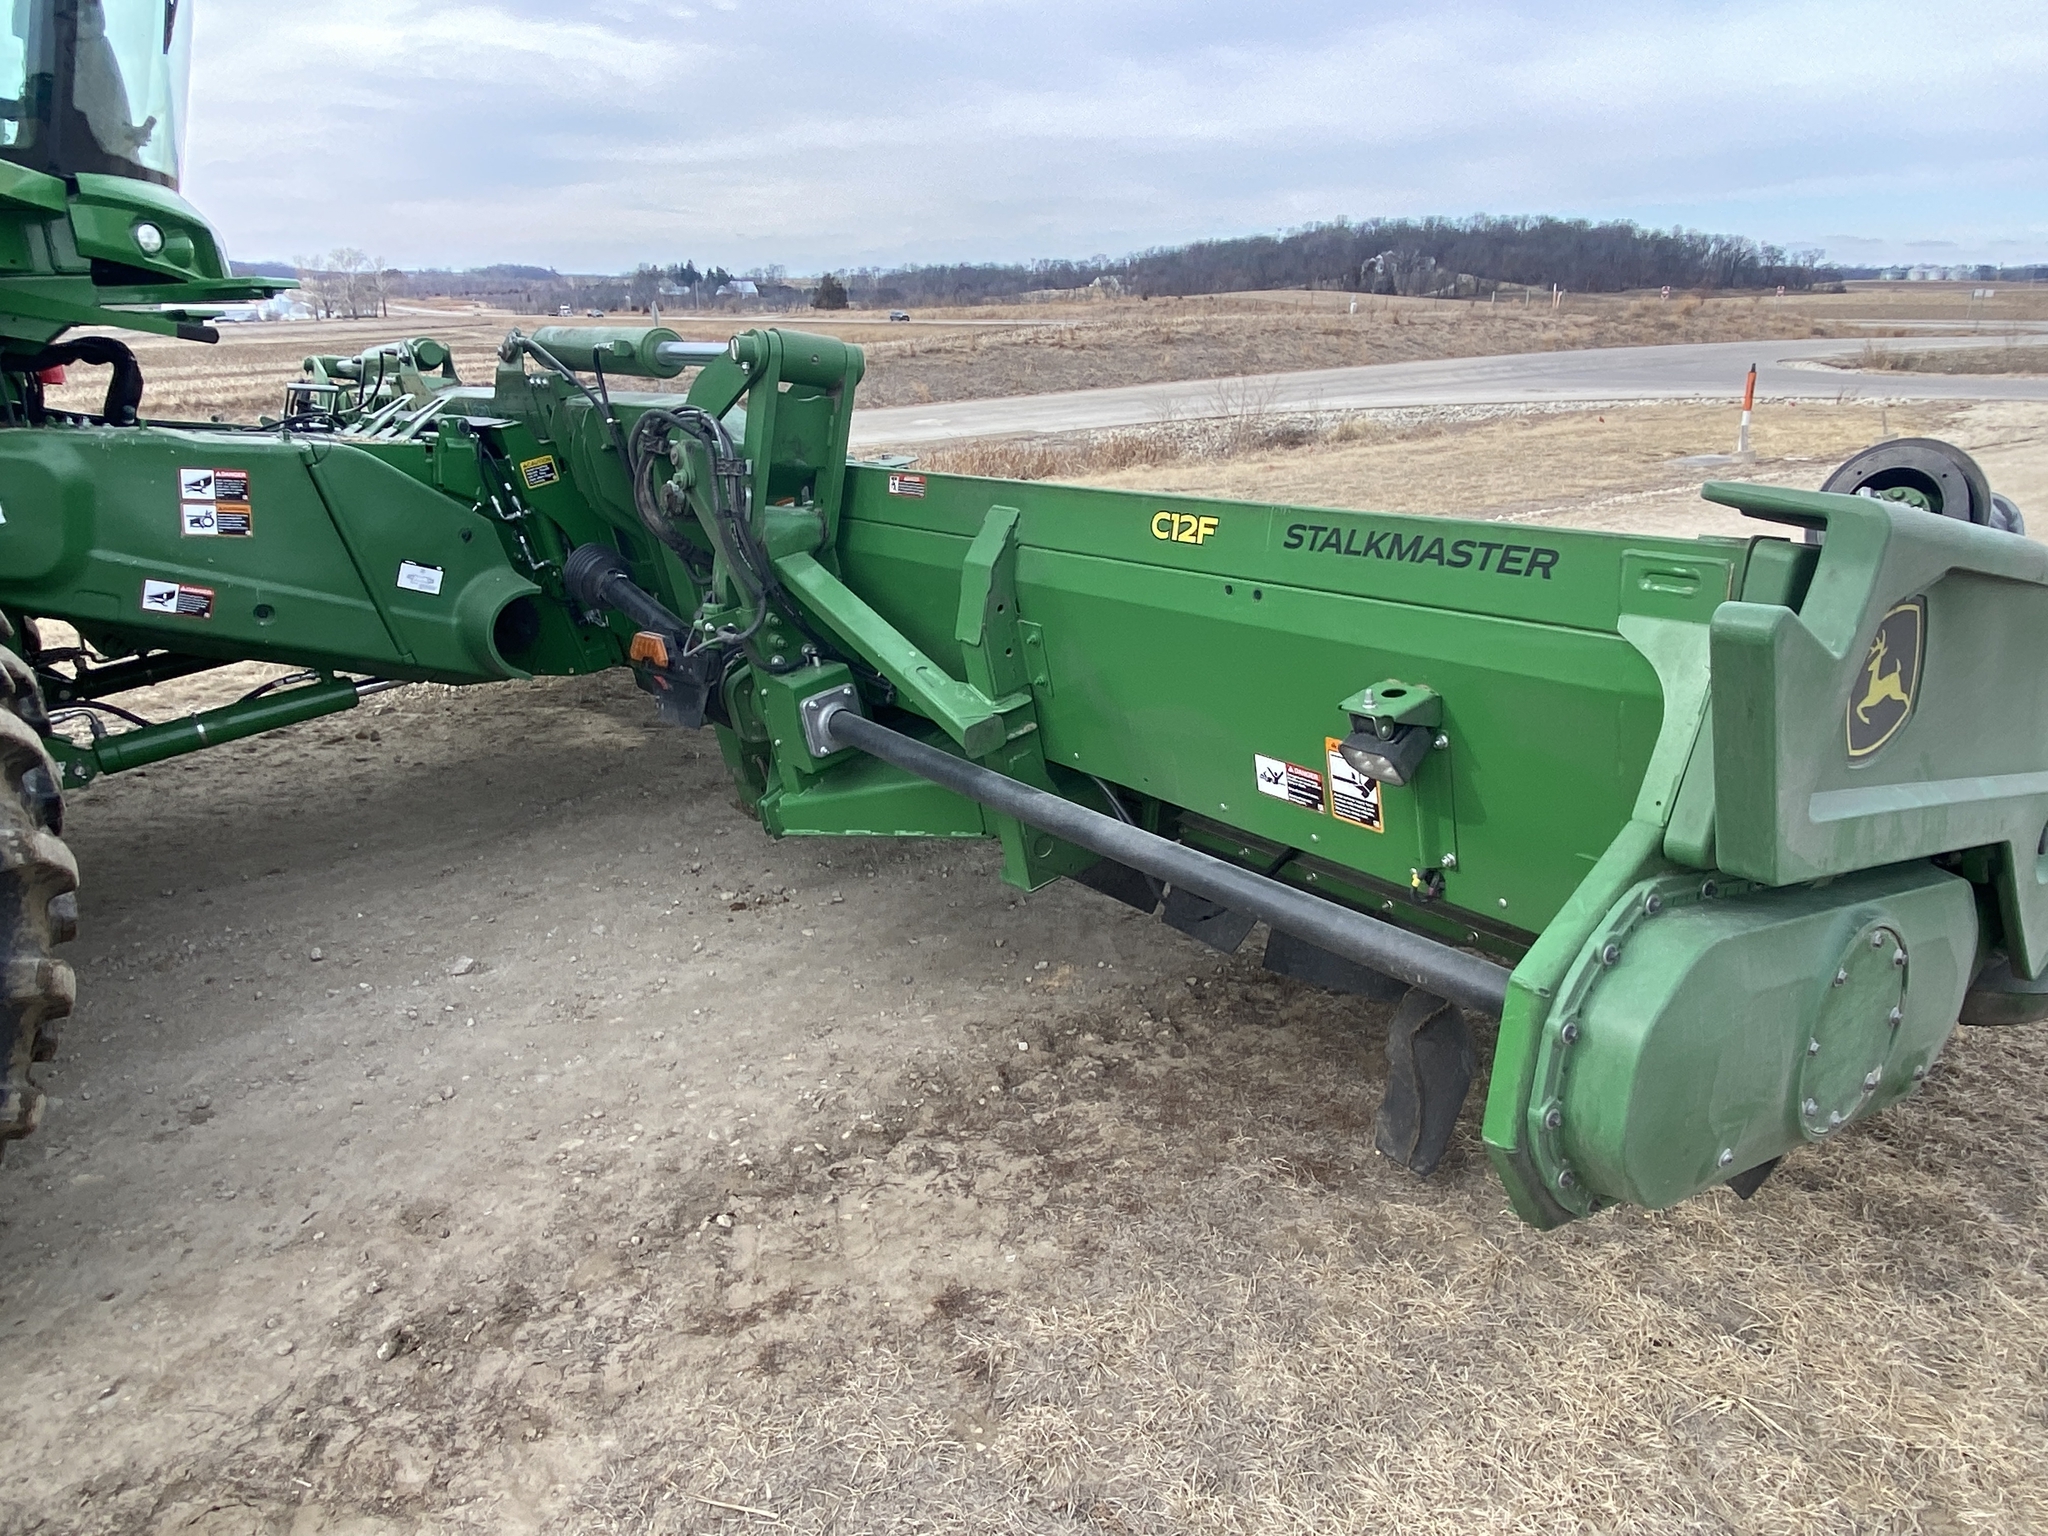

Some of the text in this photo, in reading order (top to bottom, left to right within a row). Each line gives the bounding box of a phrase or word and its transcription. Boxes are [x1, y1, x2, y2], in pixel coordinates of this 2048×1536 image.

[1150, 510, 1220, 545] C12F
[1283, 523, 1560, 580] STALKMASTER
[1294, 767, 1319, 780] DANGER
